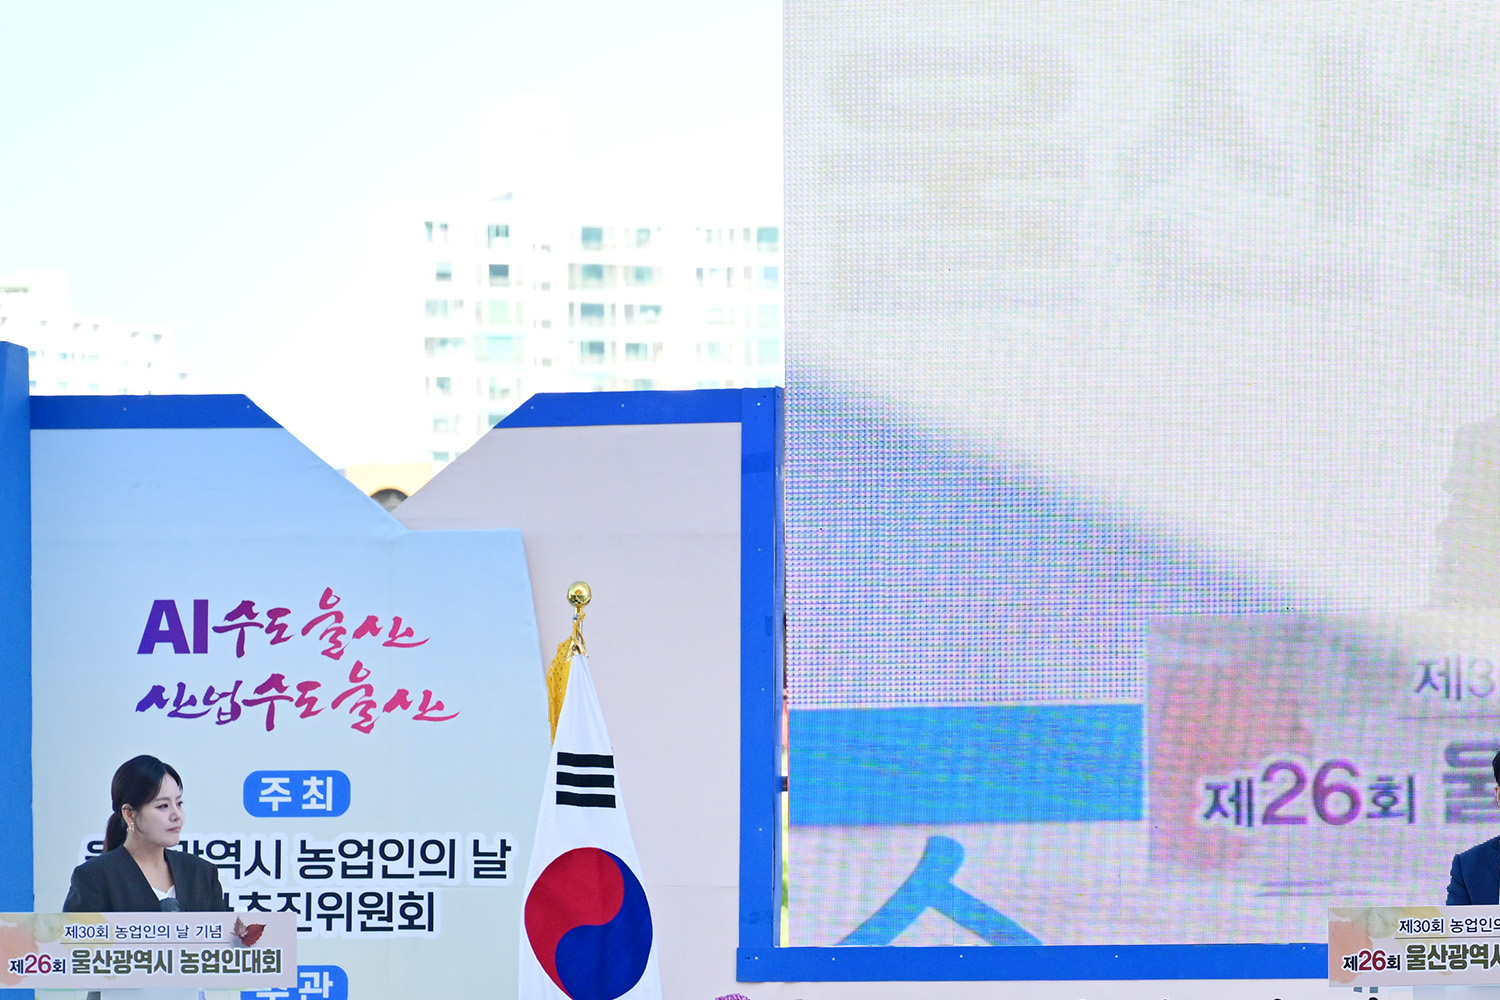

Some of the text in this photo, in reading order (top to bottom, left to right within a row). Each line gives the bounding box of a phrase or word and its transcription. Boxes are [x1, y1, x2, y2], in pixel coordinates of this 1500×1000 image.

[1203, 759, 1417, 826] 제26회
[298, 838, 456, 879] 농업인의
[474, 838, 511, 879] 날
[65, 925, 222, 939] 제30회 농업인의 날 기념
[1399, 919, 1444, 934] 제30회
[9, 949, 281, 974] 제26회 울산광역시 농업인대회
[1343, 950, 1400, 972] 제26회
